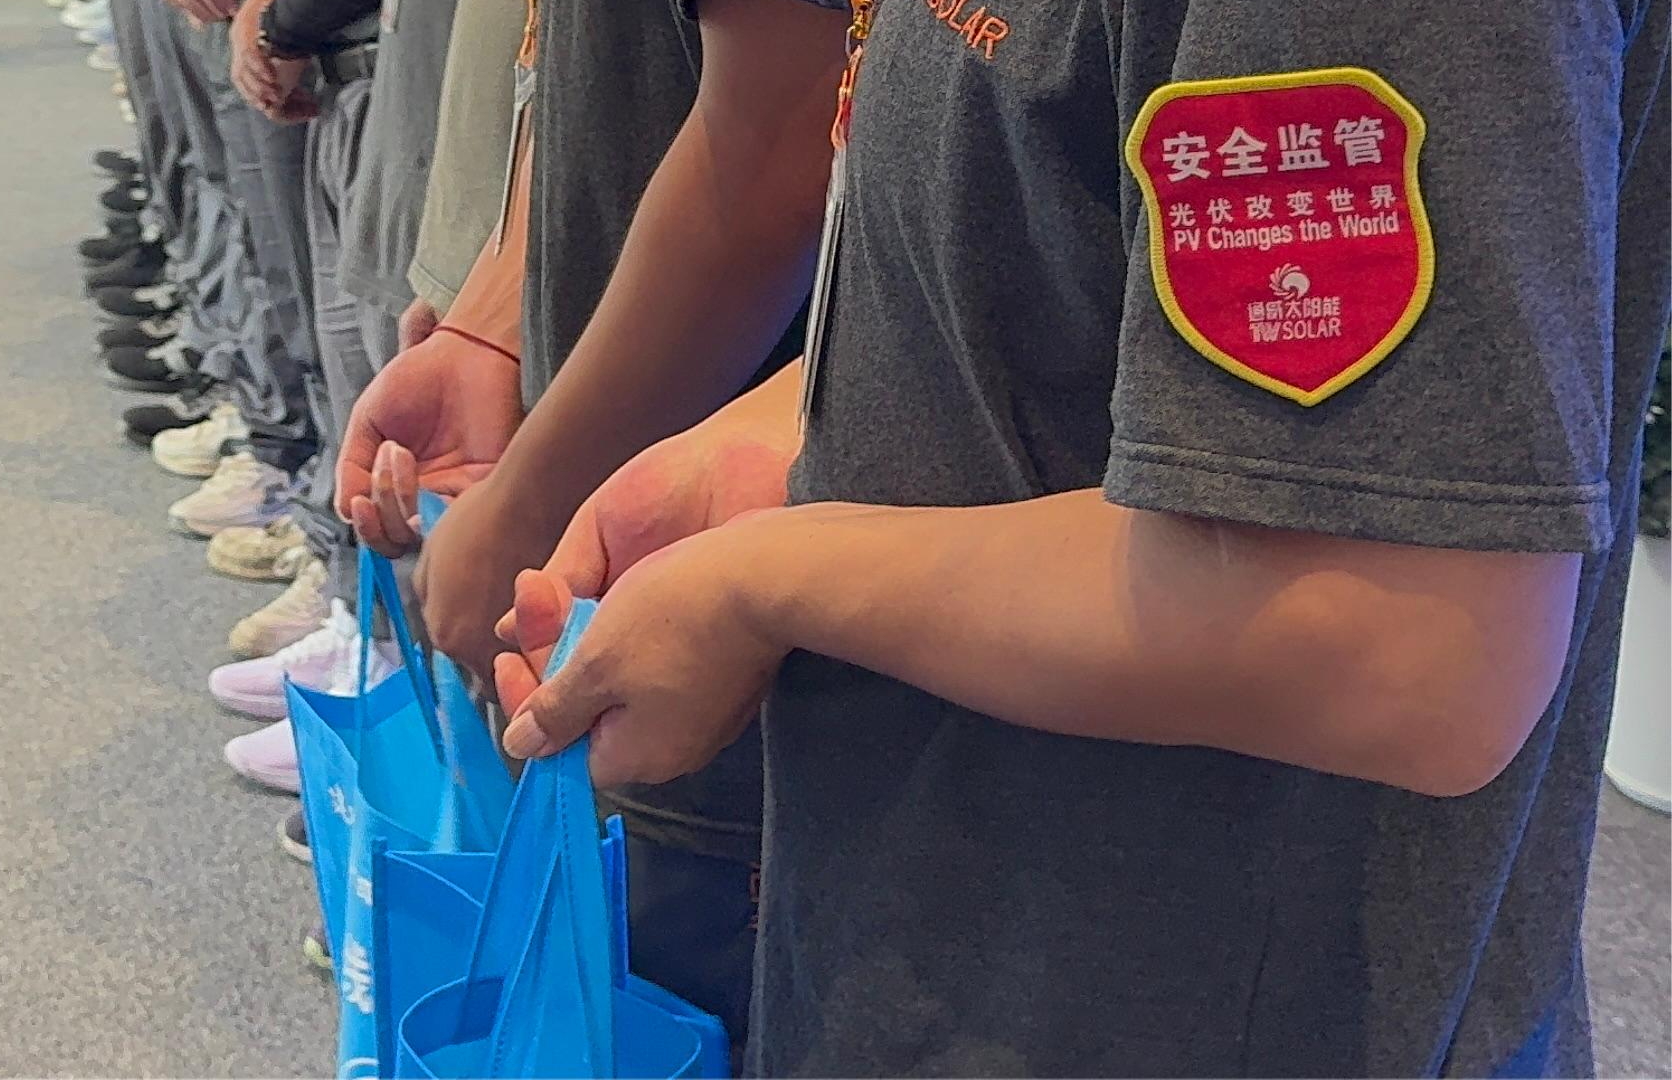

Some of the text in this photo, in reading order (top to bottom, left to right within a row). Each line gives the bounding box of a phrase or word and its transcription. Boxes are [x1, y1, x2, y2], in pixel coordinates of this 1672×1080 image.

[1162, 115, 1386, 183] 安全监管
[1168, 184, 1398, 228] 光伏改变世界
[1173, 211, 1401, 253] PV Changes the World
